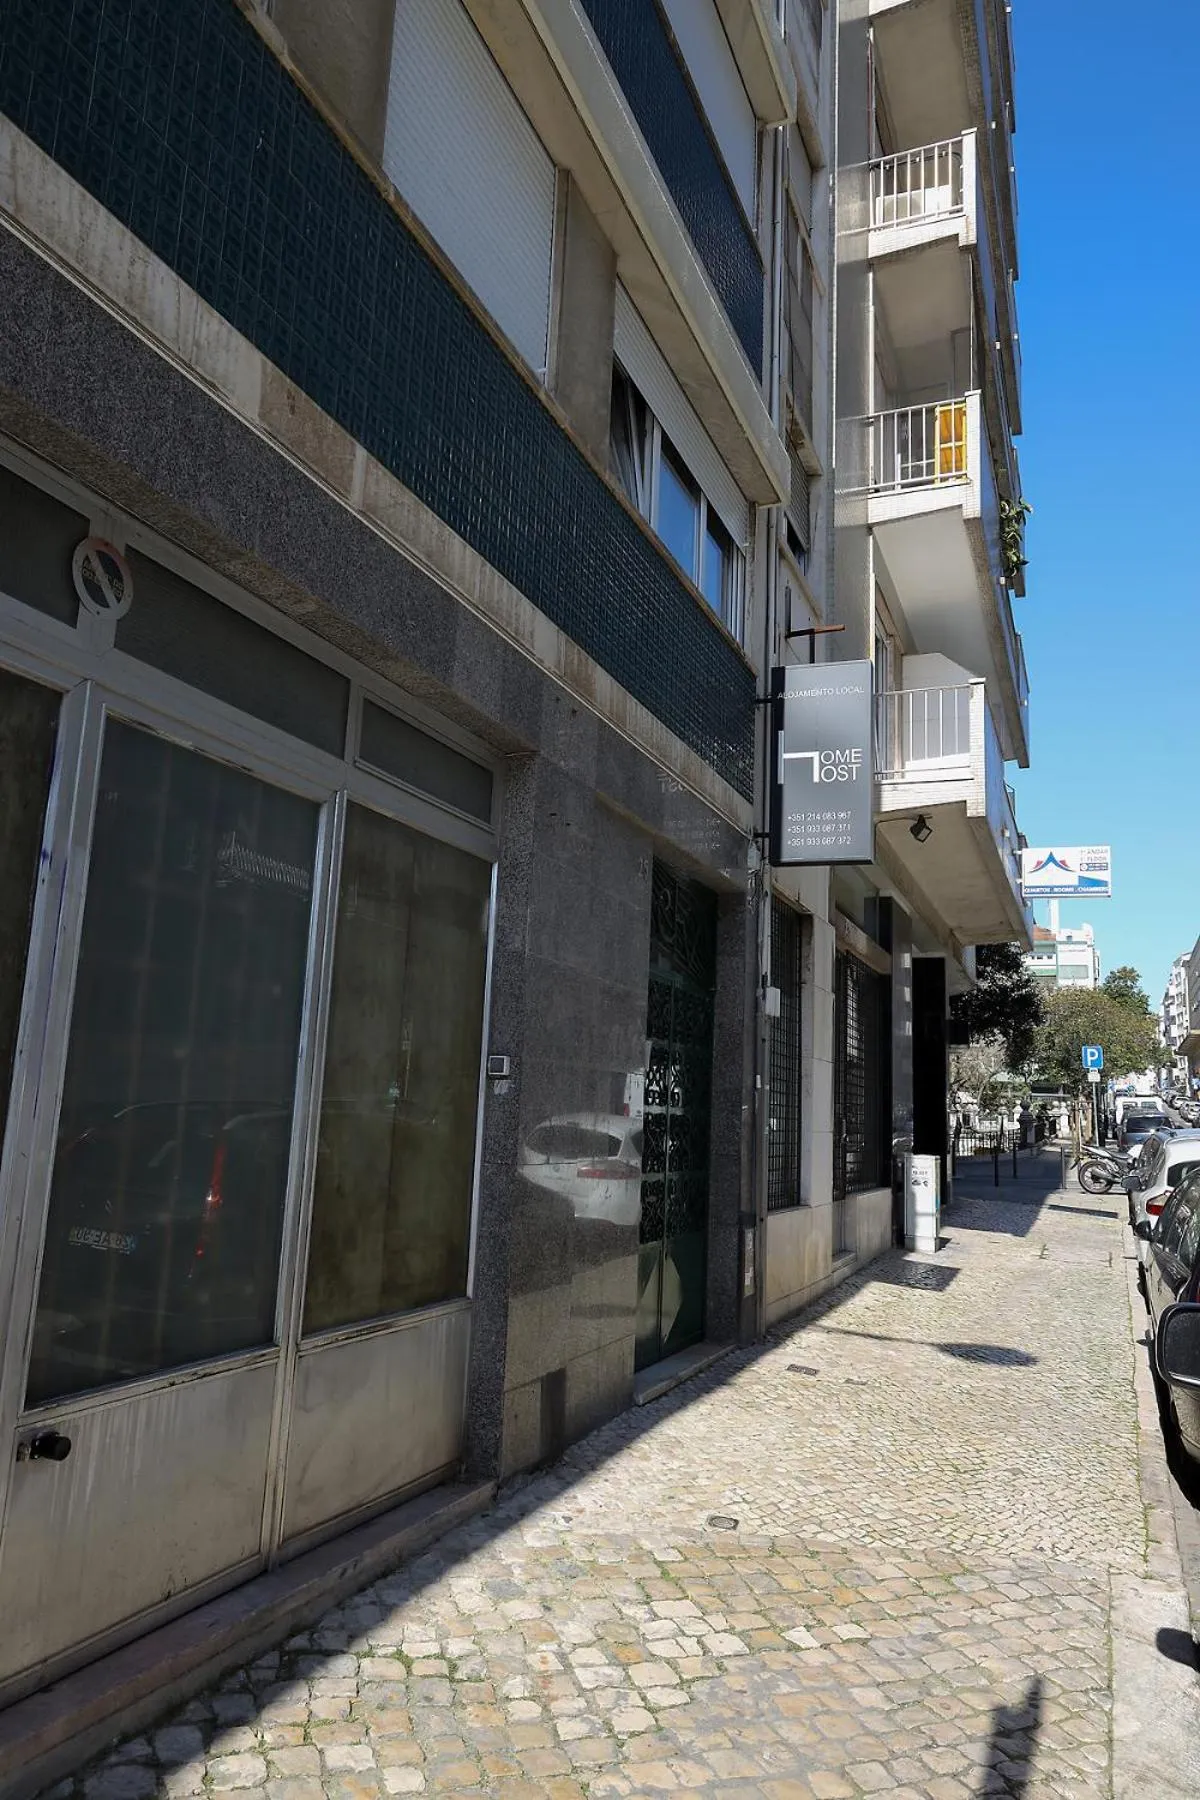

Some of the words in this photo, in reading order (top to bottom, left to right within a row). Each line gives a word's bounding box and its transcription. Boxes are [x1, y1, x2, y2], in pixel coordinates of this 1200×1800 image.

[778, 688, 834, 699] ALOJAMENTO
[836, 686, 865, 695] LOCAL
[1086, 1048, 1098, 1066] P
